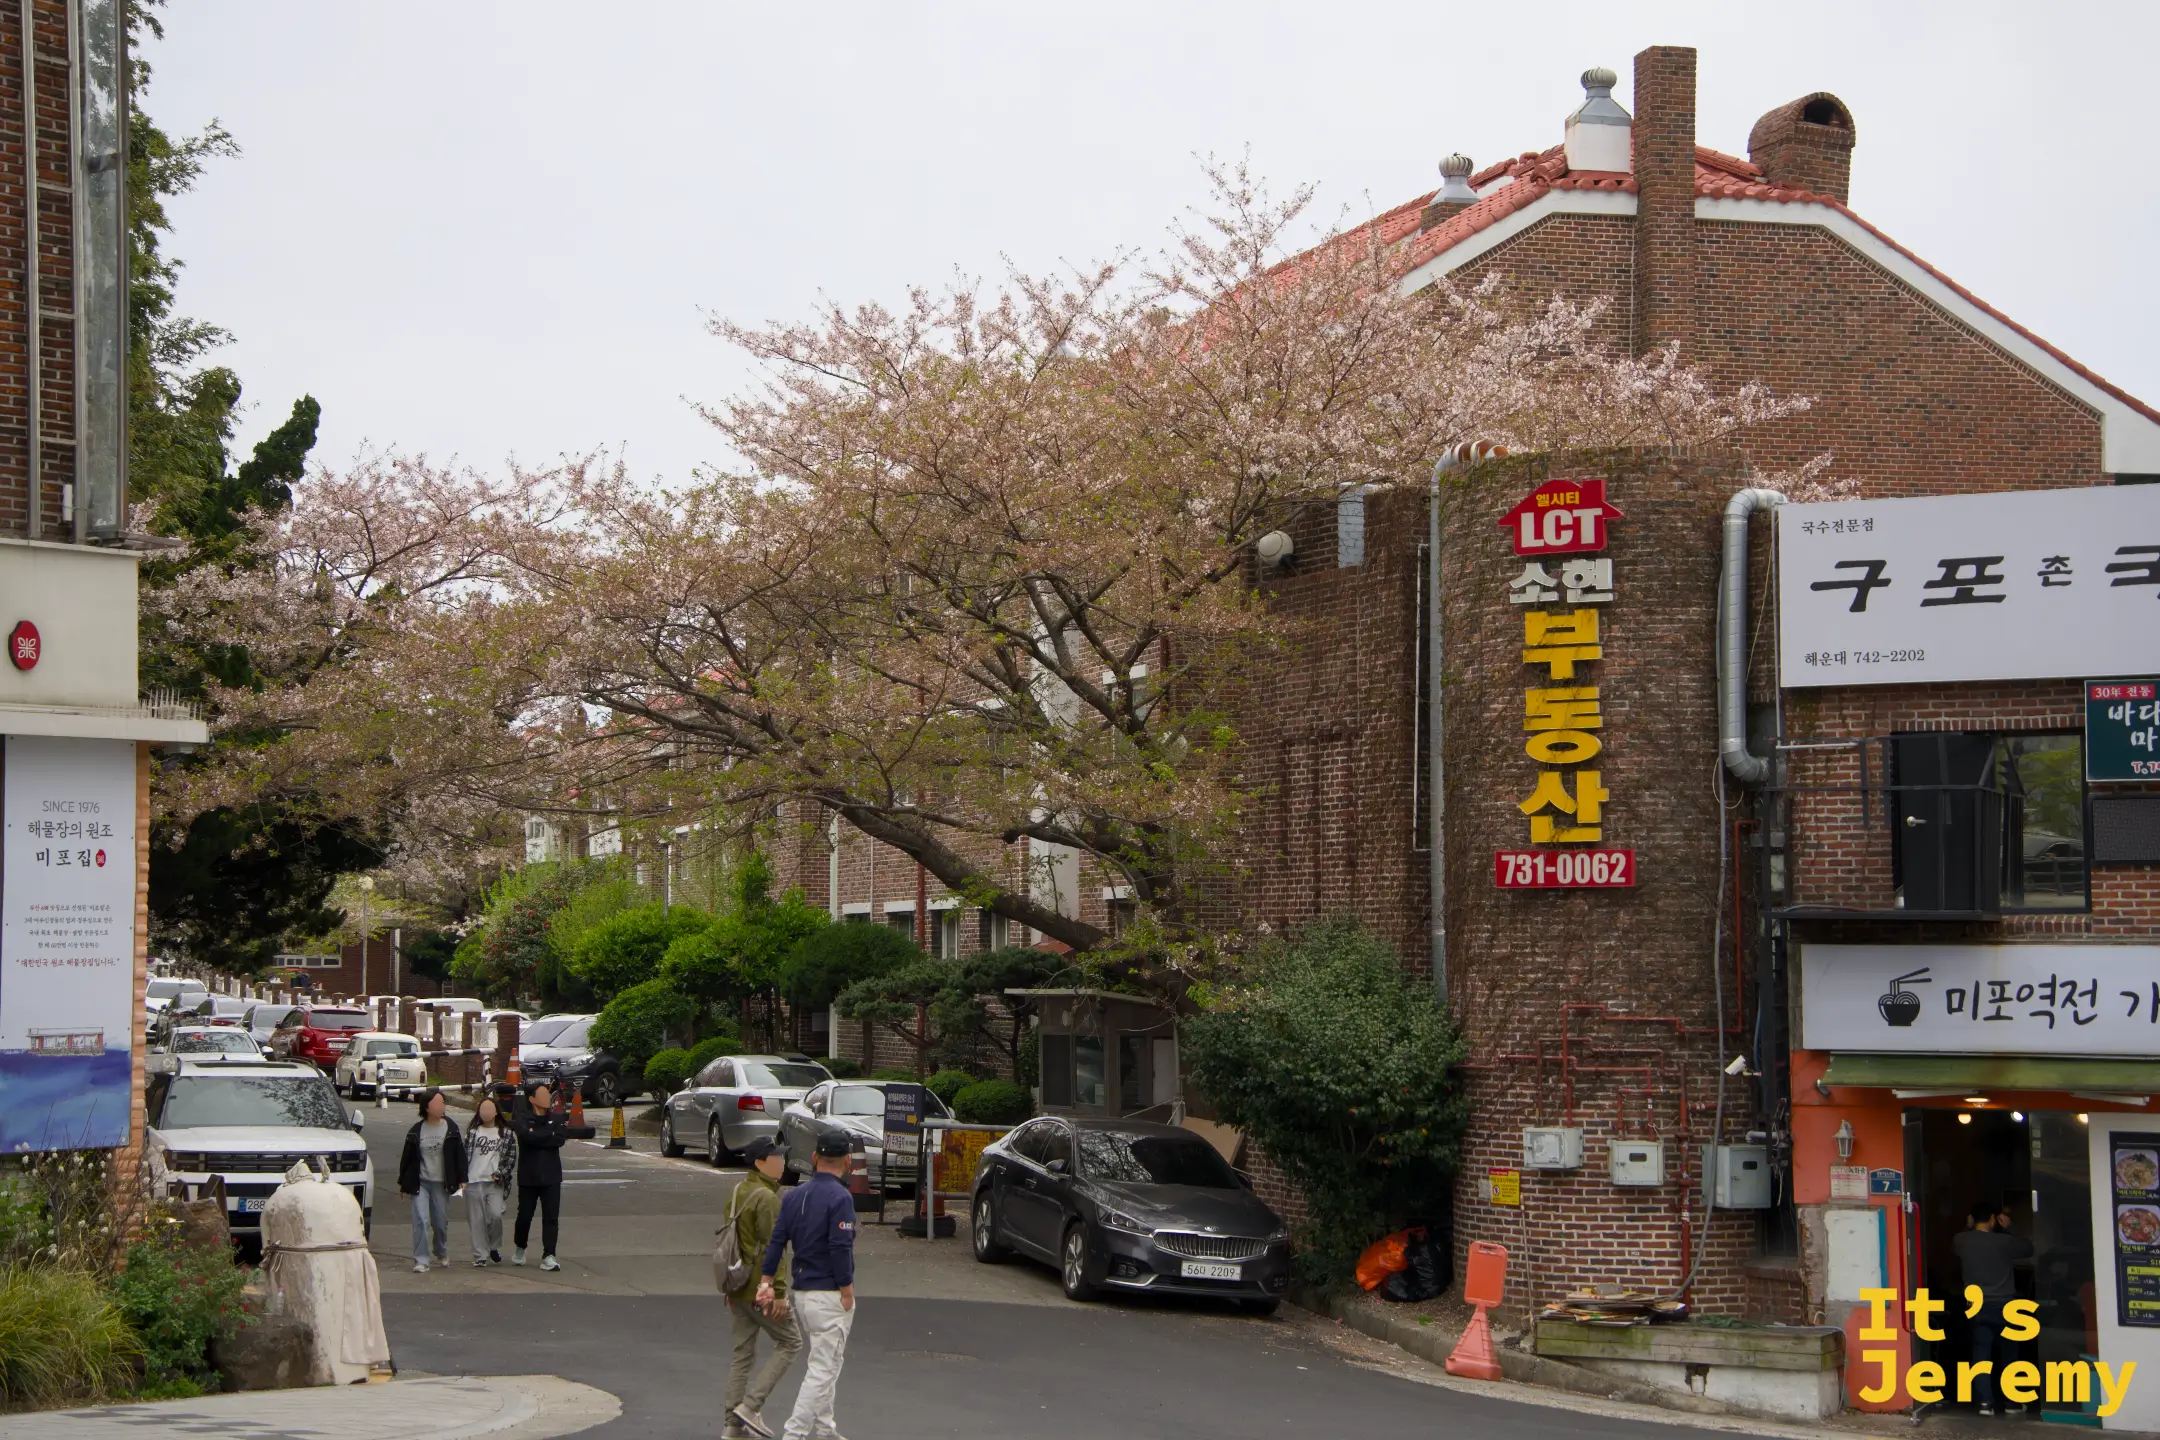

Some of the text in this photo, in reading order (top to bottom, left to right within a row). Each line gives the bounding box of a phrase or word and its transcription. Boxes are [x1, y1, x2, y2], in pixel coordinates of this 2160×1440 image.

[1536, 491, 1580, 507] 엘시티
[1520, 508, 1603, 548] LCT
[1801, 518, 1875, 535] 국수전문점
[1509, 558, 1614, 604] 소현
[1804, 649, 1925, 667] 해운대 742-2202
[2108, 700, 2160, 727] 바다
[1519, 608, 1610, 843] 부동산
[42, 800, 100, 814] SINCE 1976
[27, 820, 114, 840] 해물장의 원조
[35, 847, 92, 867] 미포집
[1501, 852, 1627, 885] 731-0062
[1945, 973, 2099, 1030] 미포역전
[1882, 1180, 1890, 1192] 7
[1211, 1266, 1235, 1278] 2209
